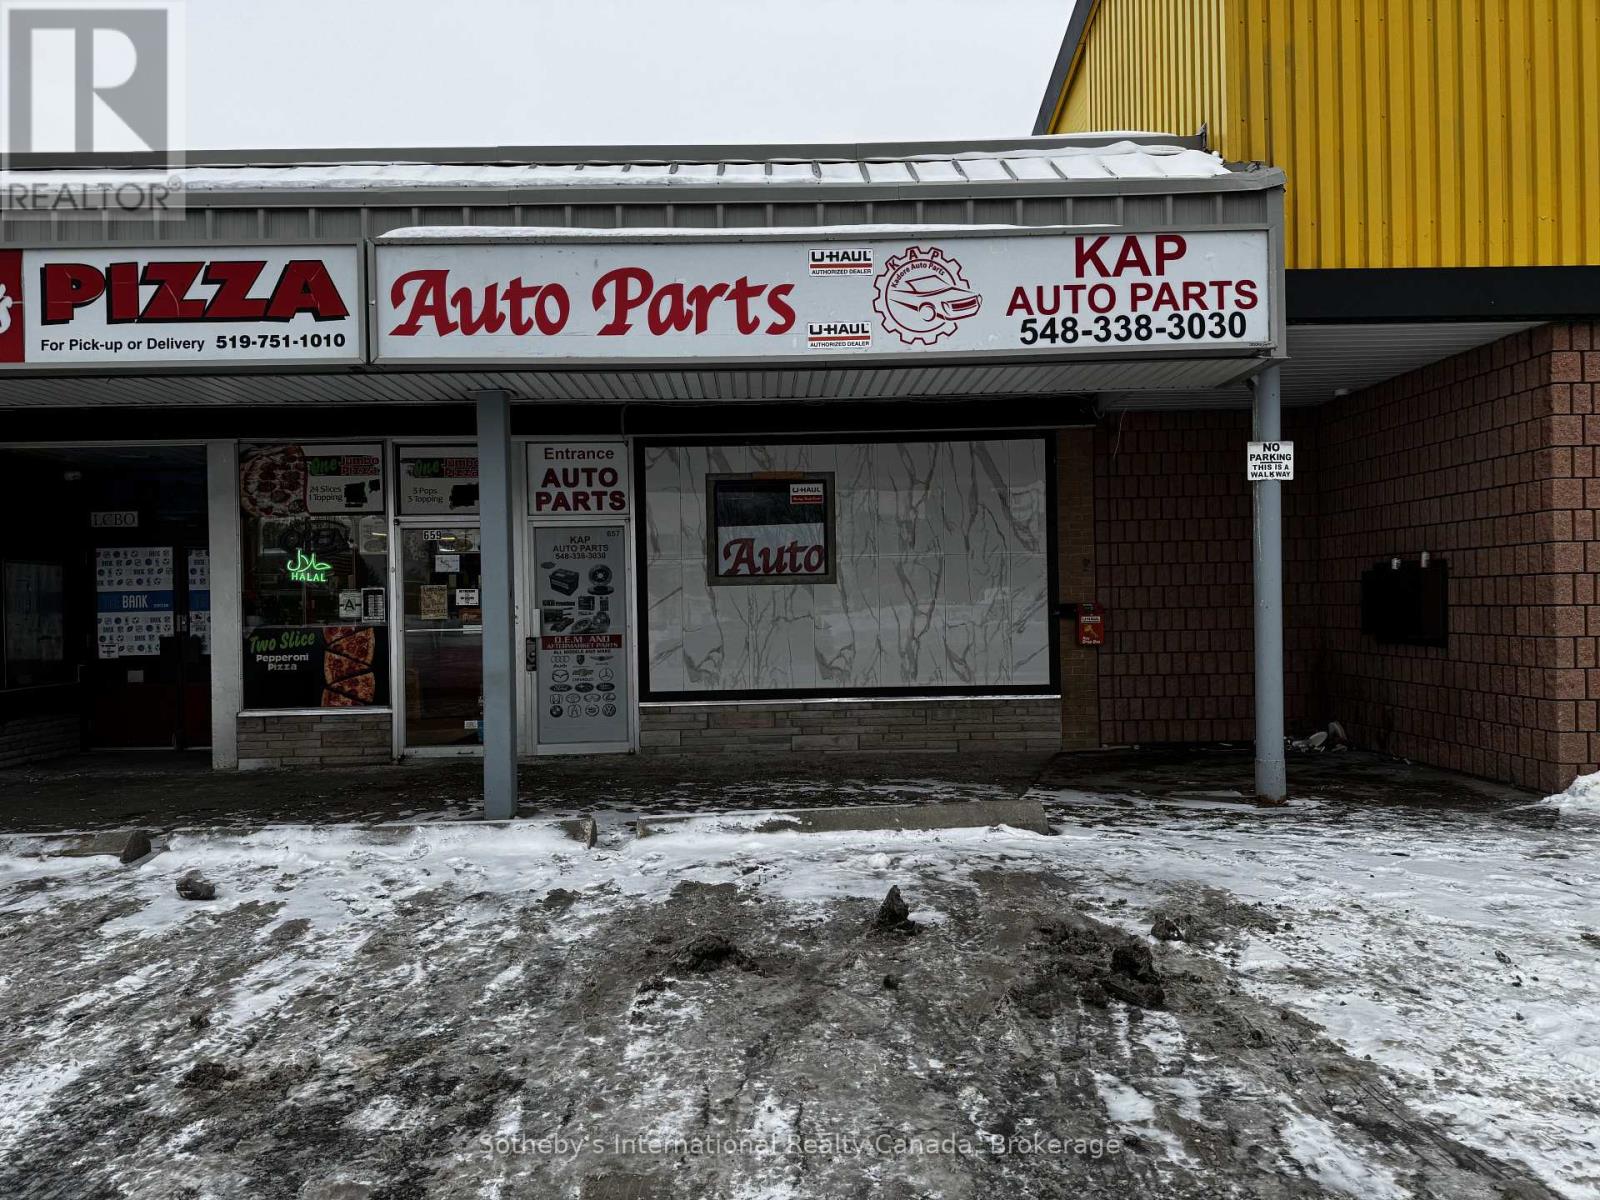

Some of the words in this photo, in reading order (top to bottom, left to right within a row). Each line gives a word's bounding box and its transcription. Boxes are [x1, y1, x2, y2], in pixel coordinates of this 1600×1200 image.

[811, 251, 872, 262] U-HAUL
[1074, 235, 1187, 278] KAP
[911, 263, 928, 271] Auto
[928, 263, 945, 276] Parts
[40, 260, 350, 326] PIZZA
[1006, 284, 1116, 316] AUTO
[1131, 280, 1258, 312] PARTS
[388, 269, 571, 337] Auto
[592, 267, 796, 336] Parts
[809, 323, 870, 335] U-HAUL
[1020, 311, 1246, 345] 548-338-3030
[41, 339, 65, 351] For
[69, 338, 123, 353] Pick-up
[127, 340, 143, 350] or
[147, 337, 205, 352] Delivery
[216, 333, 346, 349] 519-751-1010
[544, 447, 614, 460] Entrance
[1262, 442, 1280, 452] NO
[1249, 453, 1292, 461] PARKING
[541, 467, 618, 488] AUTO
[419, 487, 438, 496] Pops
[313, 494, 343, 503] Topping
[535, 490, 626, 511] PARTS
[424, 530, 442, 540] 659
[570, 535, 591, 544] KAP
[580, 544, 609, 552] PARTS
[722, 538, 825, 576] Auto
[290, 572, 327, 583] HALAL
[122, 594, 149, 609] BANK
[249, 635, 277, 654] Two
[279, 630, 316, 650] Slice
[255, 653, 309, 663] Pepperoni
[267, 663, 298, 671] Pizza
